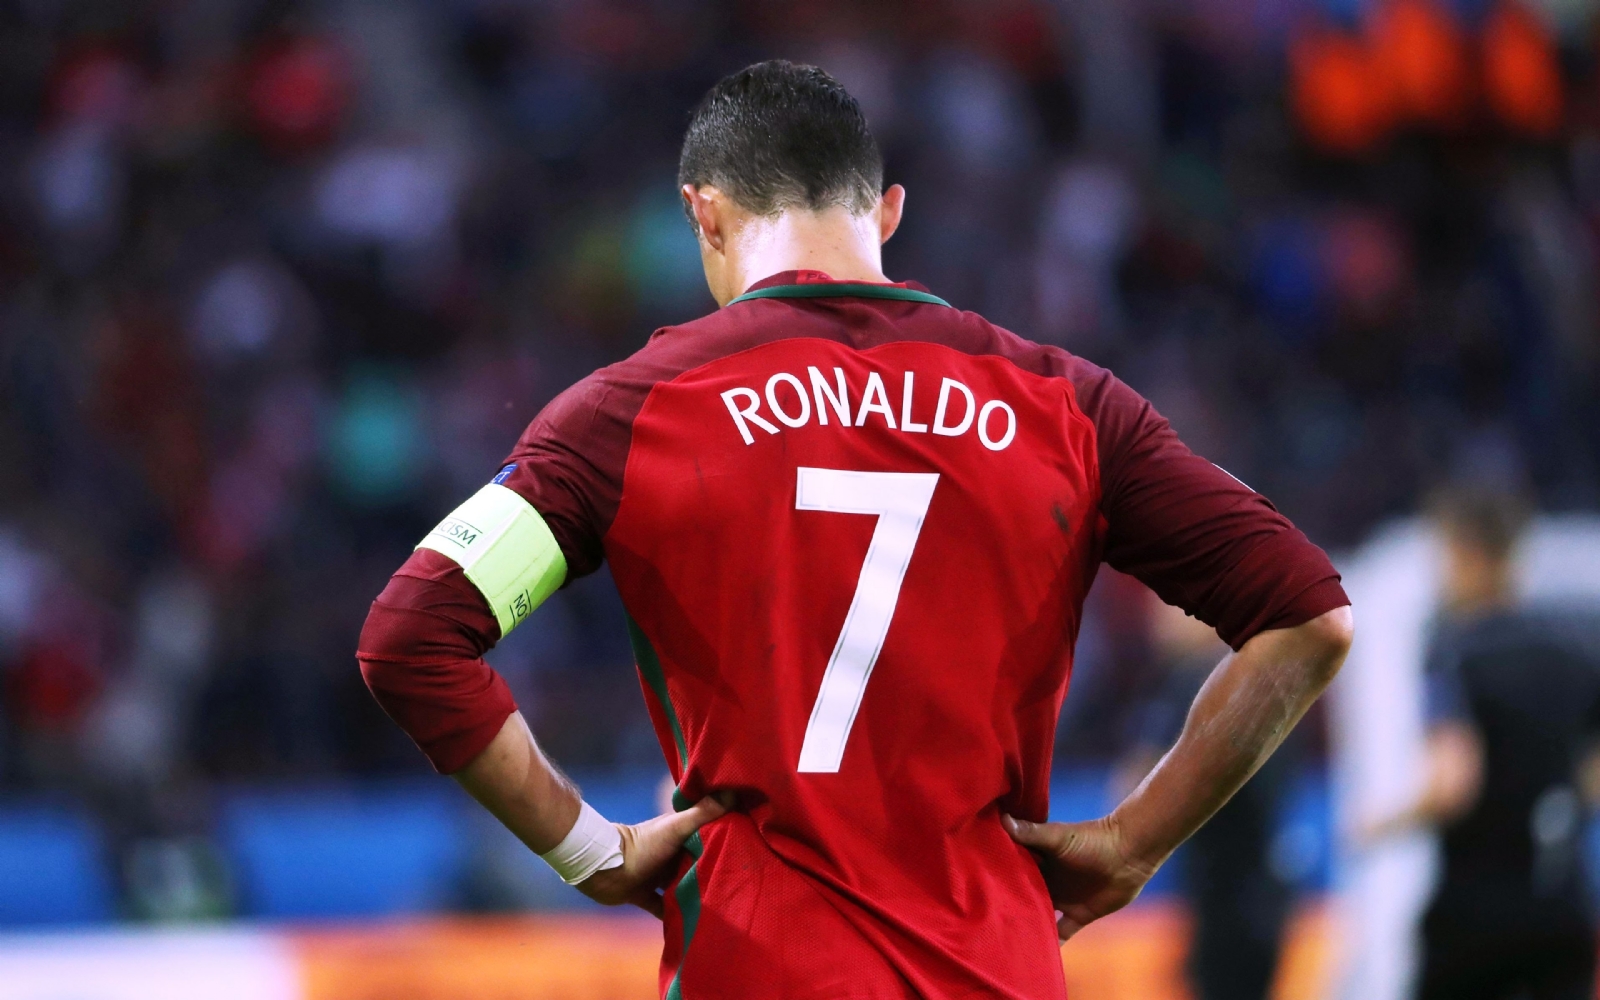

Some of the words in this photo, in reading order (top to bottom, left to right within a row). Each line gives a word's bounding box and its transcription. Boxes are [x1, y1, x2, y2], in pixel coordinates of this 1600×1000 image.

[720, 366, 1016, 451] RONALDO
[513, 593, 528, 617] NO
[795, 466, 940, 773] 7
